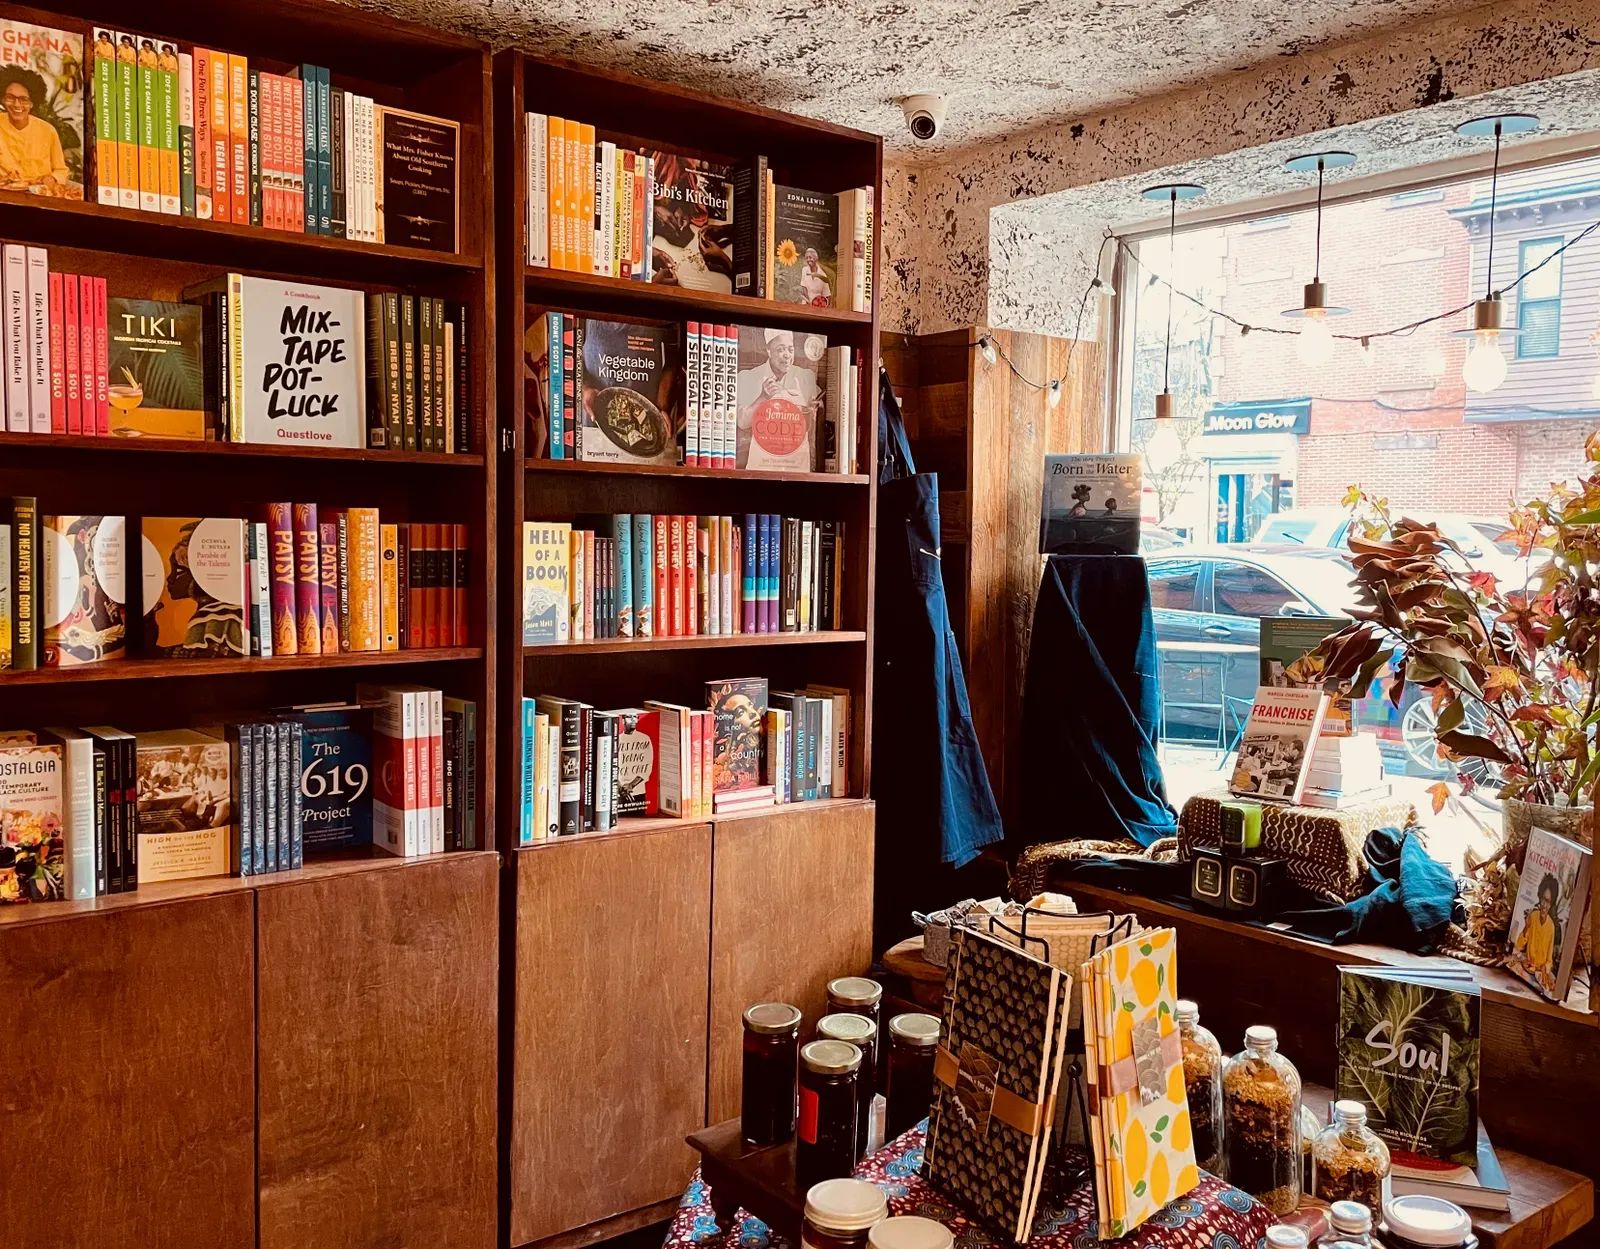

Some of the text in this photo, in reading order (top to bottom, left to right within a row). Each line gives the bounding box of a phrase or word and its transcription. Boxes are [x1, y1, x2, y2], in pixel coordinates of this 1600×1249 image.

[3, 29, 73, 55] GHANA
[215, 62, 225, 192] RACHEL AMA'S VEGAN EATS
[263, 78, 271, 163] SWEET POTATO SOUL
[386, 142, 402, 152] What
[417, 148, 434, 157] Fisher
[434, 152, 454, 161] Knows
[550, 136, 558, 160] Table
[392, 152, 448, 169] About Old Southern
[407, 164, 433, 175] Cooking
[557, 137, 565, 184] Everyone's
[653, 182, 729, 209] Bibi's Kitchen
[787, 193, 825, 206] EDNA LEWIS
[12, 290, 21, 305] Life
[289, 291, 321, 300] Cookbook
[13, 316, 21, 338] What
[121, 313, 175, 338] TIKI
[280, 305, 341, 335] MIX-
[13, 339, 21, 354] You
[52, 323, 61, 369] COOKING
[67, 324, 77, 370] COOKING
[282, 336, 347, 366] TAPE
[13, 356, 22, 376] Bake
[598, 353, 655, 370] Vegetable
[53, 372, 62, 398] SOLO
[262, 363, 323, 393] POT-
[598, 367, 649, 382] Kingdom
[688, 341, 698, 408] SENEGAL
[702, 343, 712, 409] SENEGAL
[68, 373, 78, 399] SOLO
[267, 389, 339, 419] LUCK
[766, 407, 800, 421] Jemima
[553, 420, 560, 428] OF
[755, 420, 802, 436] CODE
[1205, 412, 1297, 432] Moon Glow
[276, 428, 332, 441] Questlove
[1052, 463, 1083, 475] Born
[1096, 463, 1133, 474] Water
[339, 519, 347, 548] BUTTER
[366, 523, 375, 545] LOVE
[529, 529, 565, 545] HELL
[534, 549, 561, 561] OF A
[657, 521, 665, 569] OPAL NEV
[274, 530, 294, 585] PATSY
[299, 530, 318, 585] PATSY
[321, 544, 337, 589] PATSY
[367, 551, 375, 581] SONGS
[18, 523, 30, 644] NO HEAVEN FOR GOOD BOYS
[340, 575, 348, 588] PIG
[526, 565, 567, 581] BOOK
[524, 619, 553, 630] Jason Mott
[1252, 704, 1315, 721] FRANCHISE
[311, 742, 341, 756] The
[525, 735, 533, 763] FARMING
[622, 752, 644, 764] YOUNG
[612, 758, 618, 766] MY
[631, 763, 649, 774] CHEF
[795, 752, 804, 778] WARRIOR
[467, 740, 475, 811] FARMING WHILE BLACK
[524, 765, 533, 783] WHILE
[97, 803, 105, 824] Matters
[303, 806, 351, 823] Project
[1528, 849, 1558, 873] KITCHEN
[1551, 848, 1575, 865] GHANA
[1364, 1019, 1451, 1077] Soul
[1383, 1127, 1399, 1136] TODD
